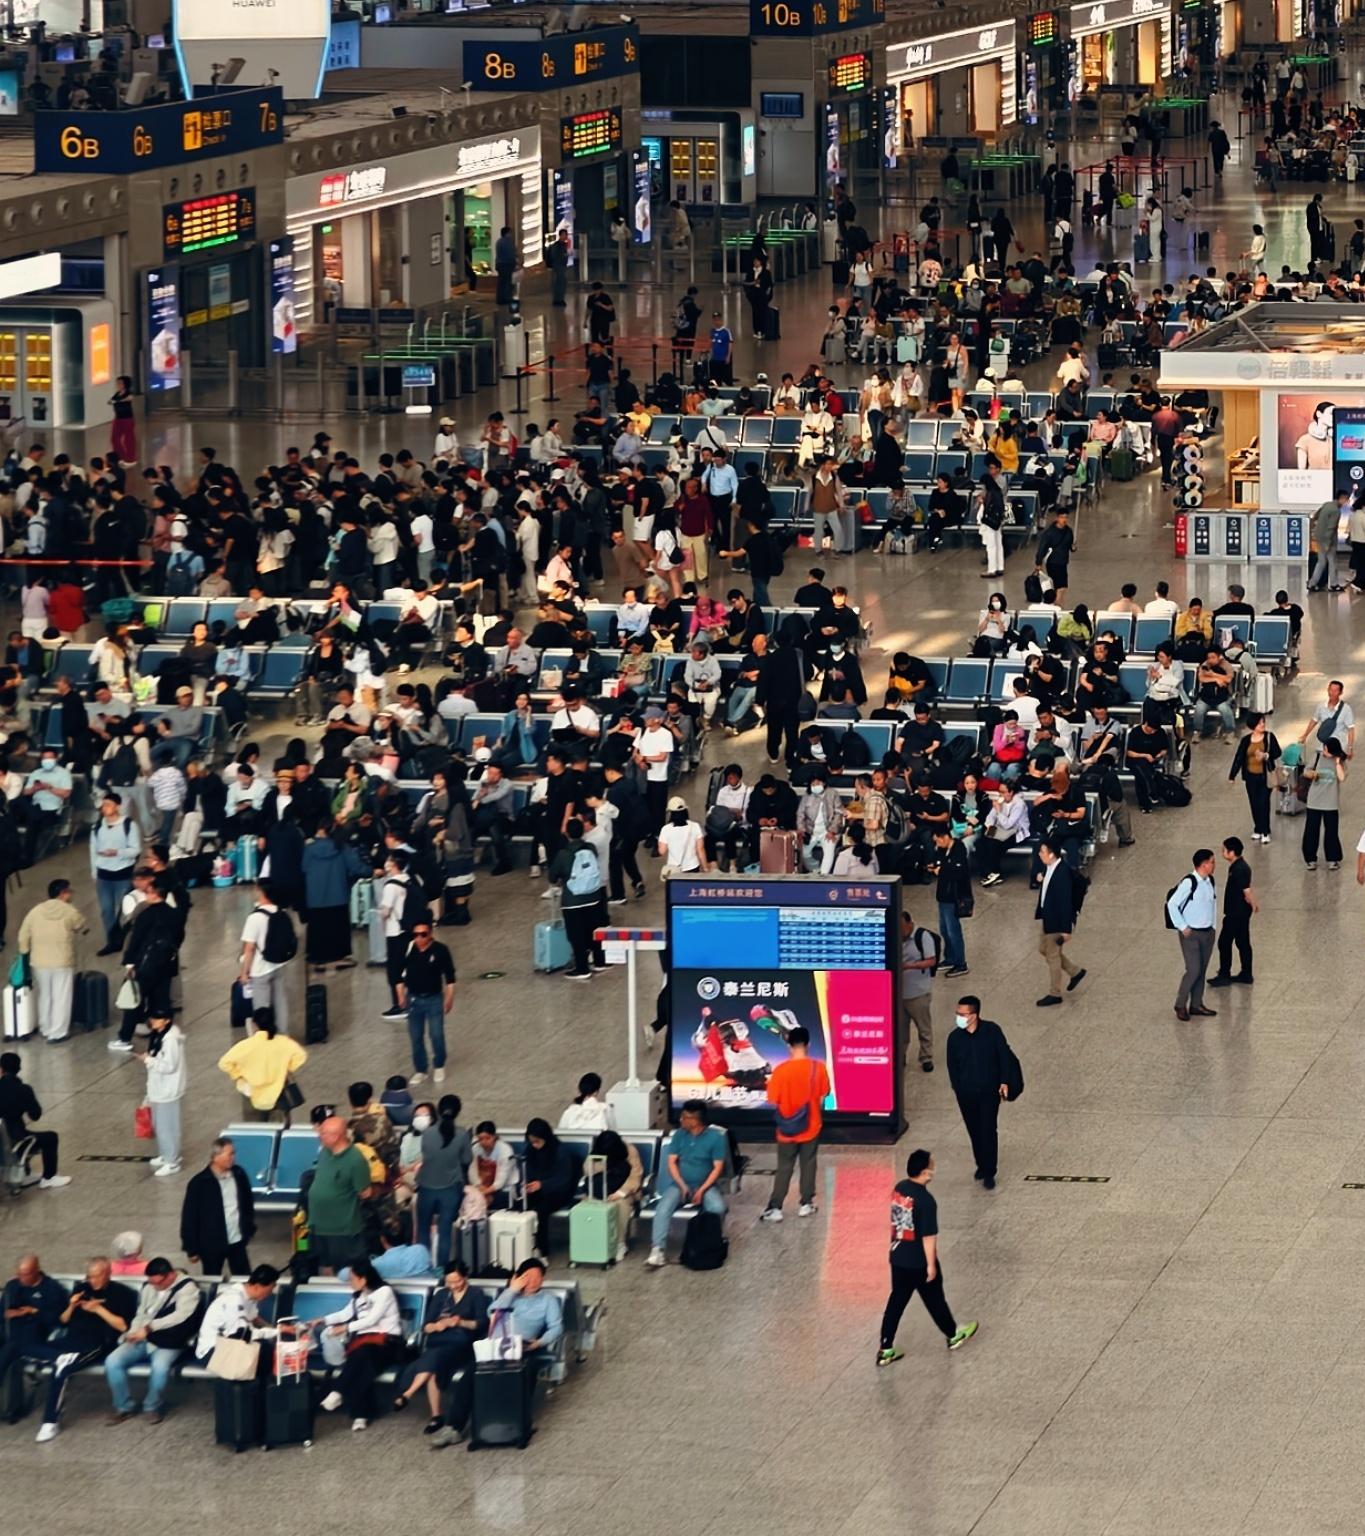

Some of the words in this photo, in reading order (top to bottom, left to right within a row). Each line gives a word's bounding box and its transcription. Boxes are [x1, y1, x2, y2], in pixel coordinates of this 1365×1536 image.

[232, 0, 276, 8] HUAWEI
[761, 3, 800, 26] 10B
[623, 38, 636, 63] 9B
[484, 52, 516, 79] 8B
[541, 51, 556, 78] 8B
[258, 103, 277, 132] 7B
[60, 126, 99, 159] 6B
[133, 125, 153, 156] 6B
[688, 887, 764, 899] 上海虹桥站欢迎您
[722, 981, 790, 999] 泰兰尼斯
